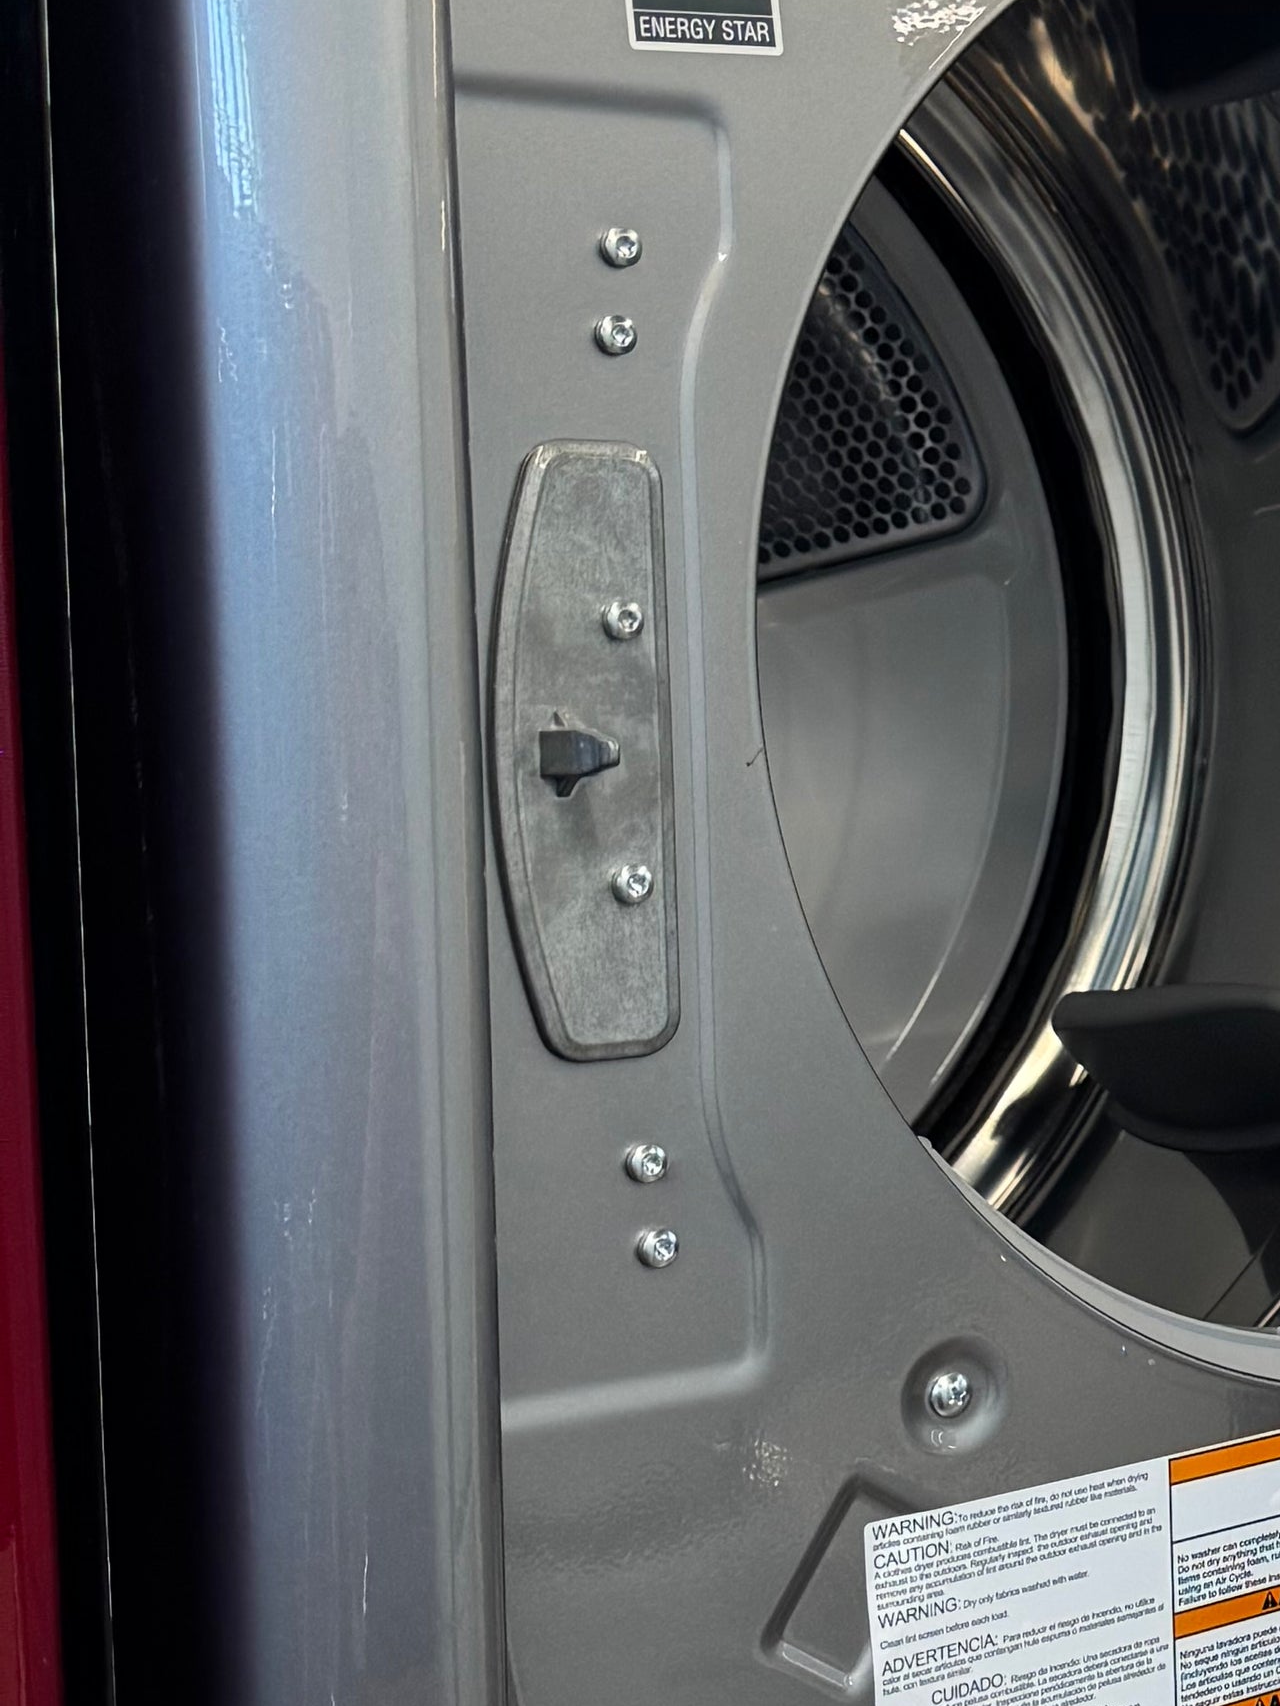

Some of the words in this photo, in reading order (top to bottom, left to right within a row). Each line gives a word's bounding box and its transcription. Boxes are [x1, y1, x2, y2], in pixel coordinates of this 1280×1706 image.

[639, 15, 715, 41] ENERGY
[722, 19, 770, 43] STAR
[872, 1511, 957, 1540] WARNING:
[873, 1541, 952, 1569] CAUTION:
[955, 1540, 971, 1551] Risk
[974, 1537, 981, 1547] of
[1177, 1553, 1189, 1563] No
[1191, 1545, 1220, 1560] washer
[1222, 1541, 1237, 1552] can
[1240, 1529, 1280, 1549] completely
[1177, 1563, 1189, 1574] Do
[1191, 1559, 1204, 1570] not
[1207, 1555, 1219, 1568] dry
[1222, 1546, 1256, 1564] anything
[1259, 1542, 1273, 1553] that
[877, 1598, 960, 1629] WARNING:
[963, 1597, 976, 1609] Dry
[881, 1634, 998, 1677] ADVERTENCIA:
[931, 1673, 1008, 1706] CUIDADO:
